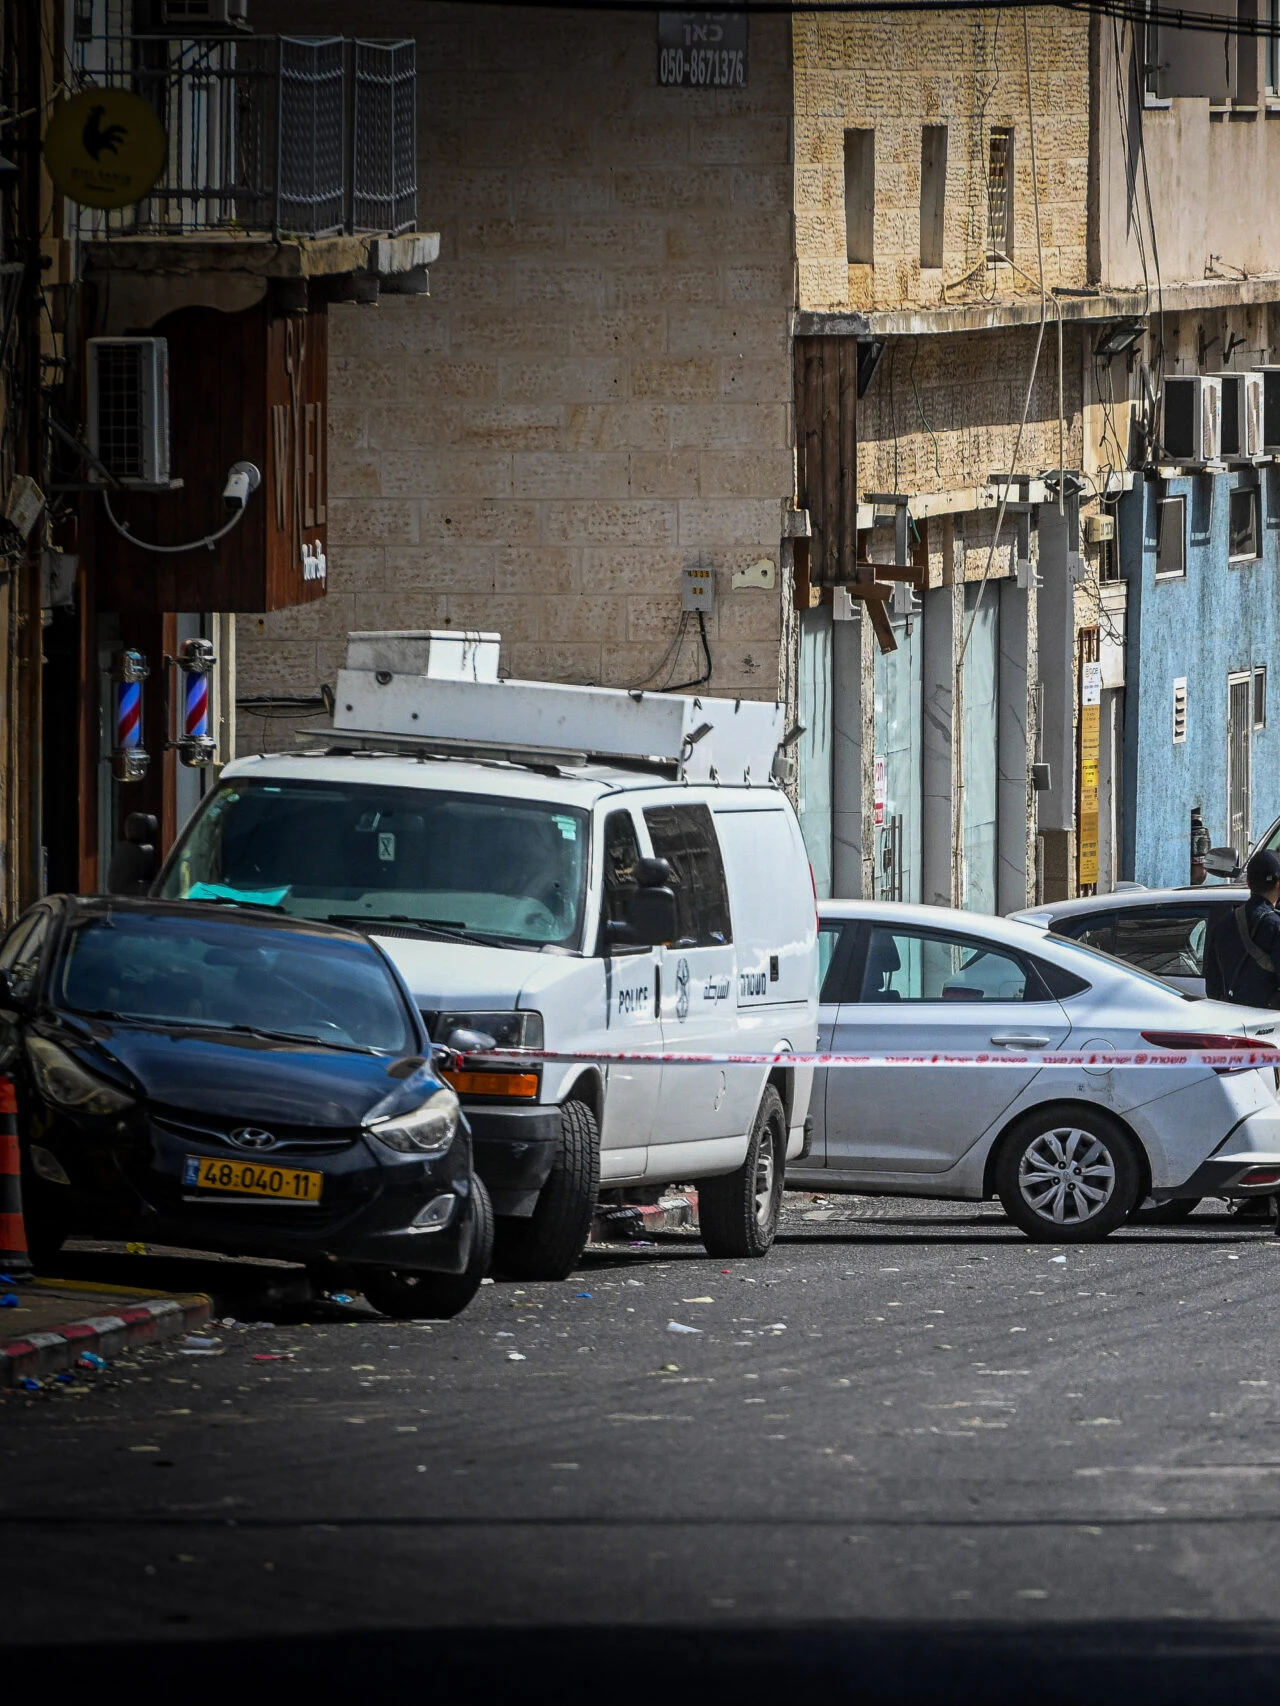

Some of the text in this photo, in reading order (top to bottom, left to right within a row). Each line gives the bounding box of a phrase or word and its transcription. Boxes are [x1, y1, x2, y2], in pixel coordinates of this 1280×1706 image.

[682, 23, 724, 46] כאן
[660, 48, 744, 84] 050-8671376
[740, 972, 767, 997] משטרה
[618, 986, 648, 1014] POLICE
